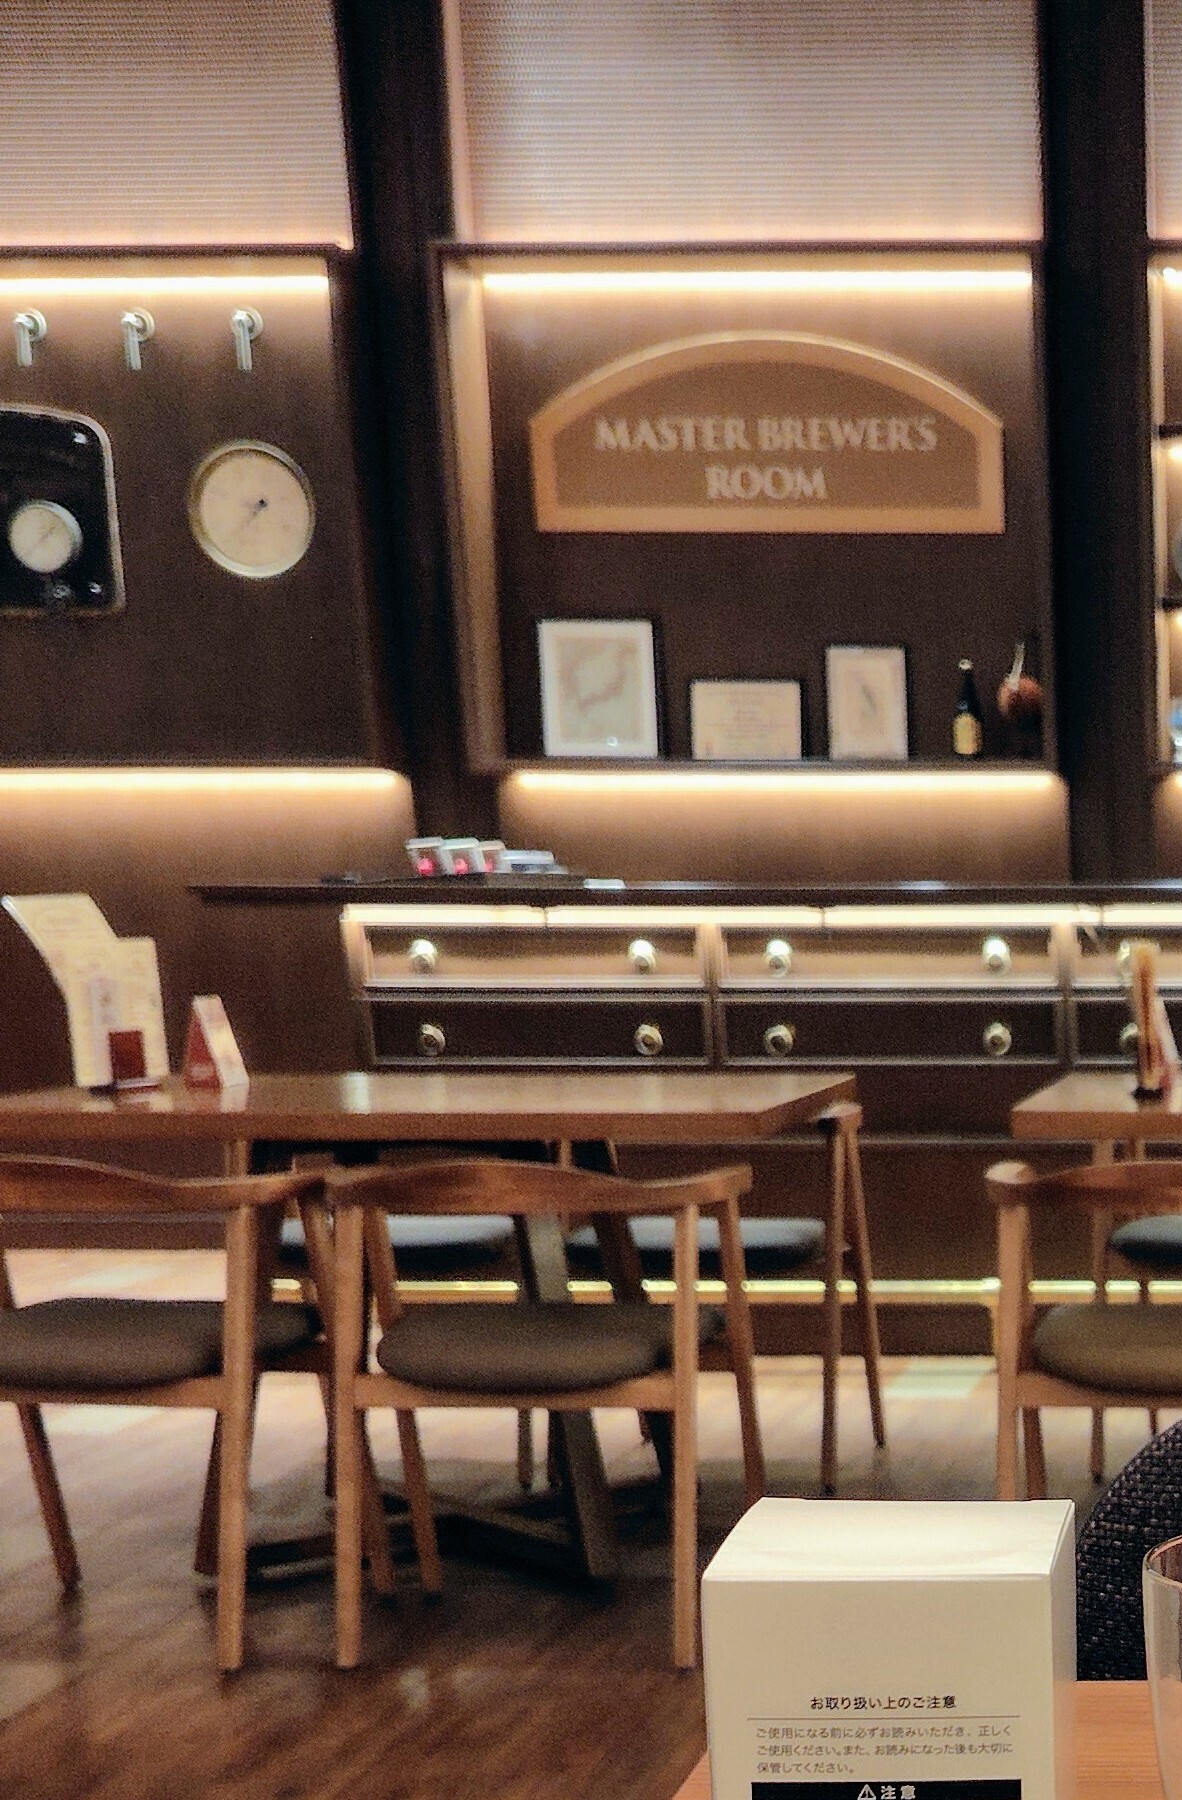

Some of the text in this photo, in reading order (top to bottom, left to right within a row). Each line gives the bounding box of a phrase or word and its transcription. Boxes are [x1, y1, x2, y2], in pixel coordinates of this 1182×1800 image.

[594, 413, 938, 452] MASTER BREWER'S
[703, 464, 828, 500] ROOM
[810, 1695, 957, 1710] お取り扱い上のご注意
[757, 1762, 854, 1774] 保管してください。
